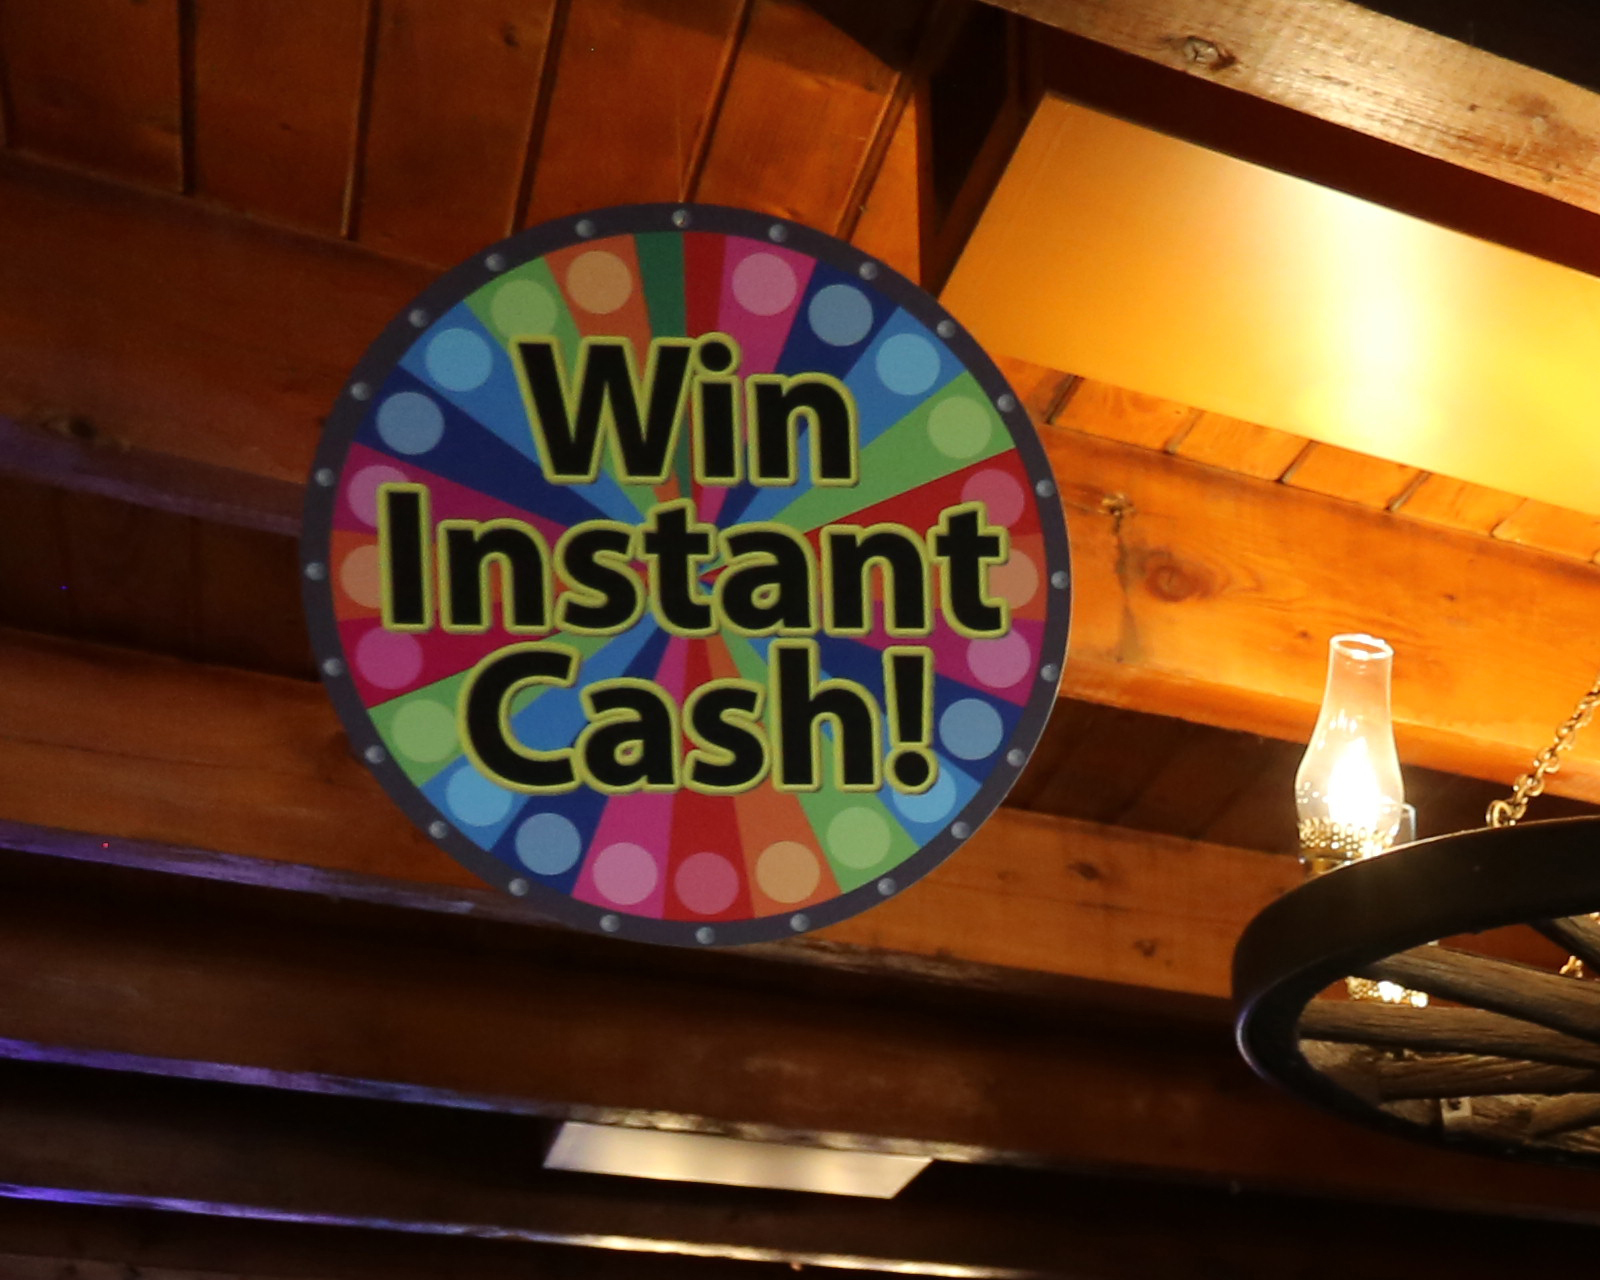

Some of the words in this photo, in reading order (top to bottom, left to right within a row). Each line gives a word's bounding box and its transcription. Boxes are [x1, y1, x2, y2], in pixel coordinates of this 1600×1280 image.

[512, 332, 860, 486] Win
[376, 482, 1009, 637] Instant
[458, 639, 939, 795] Cash!
